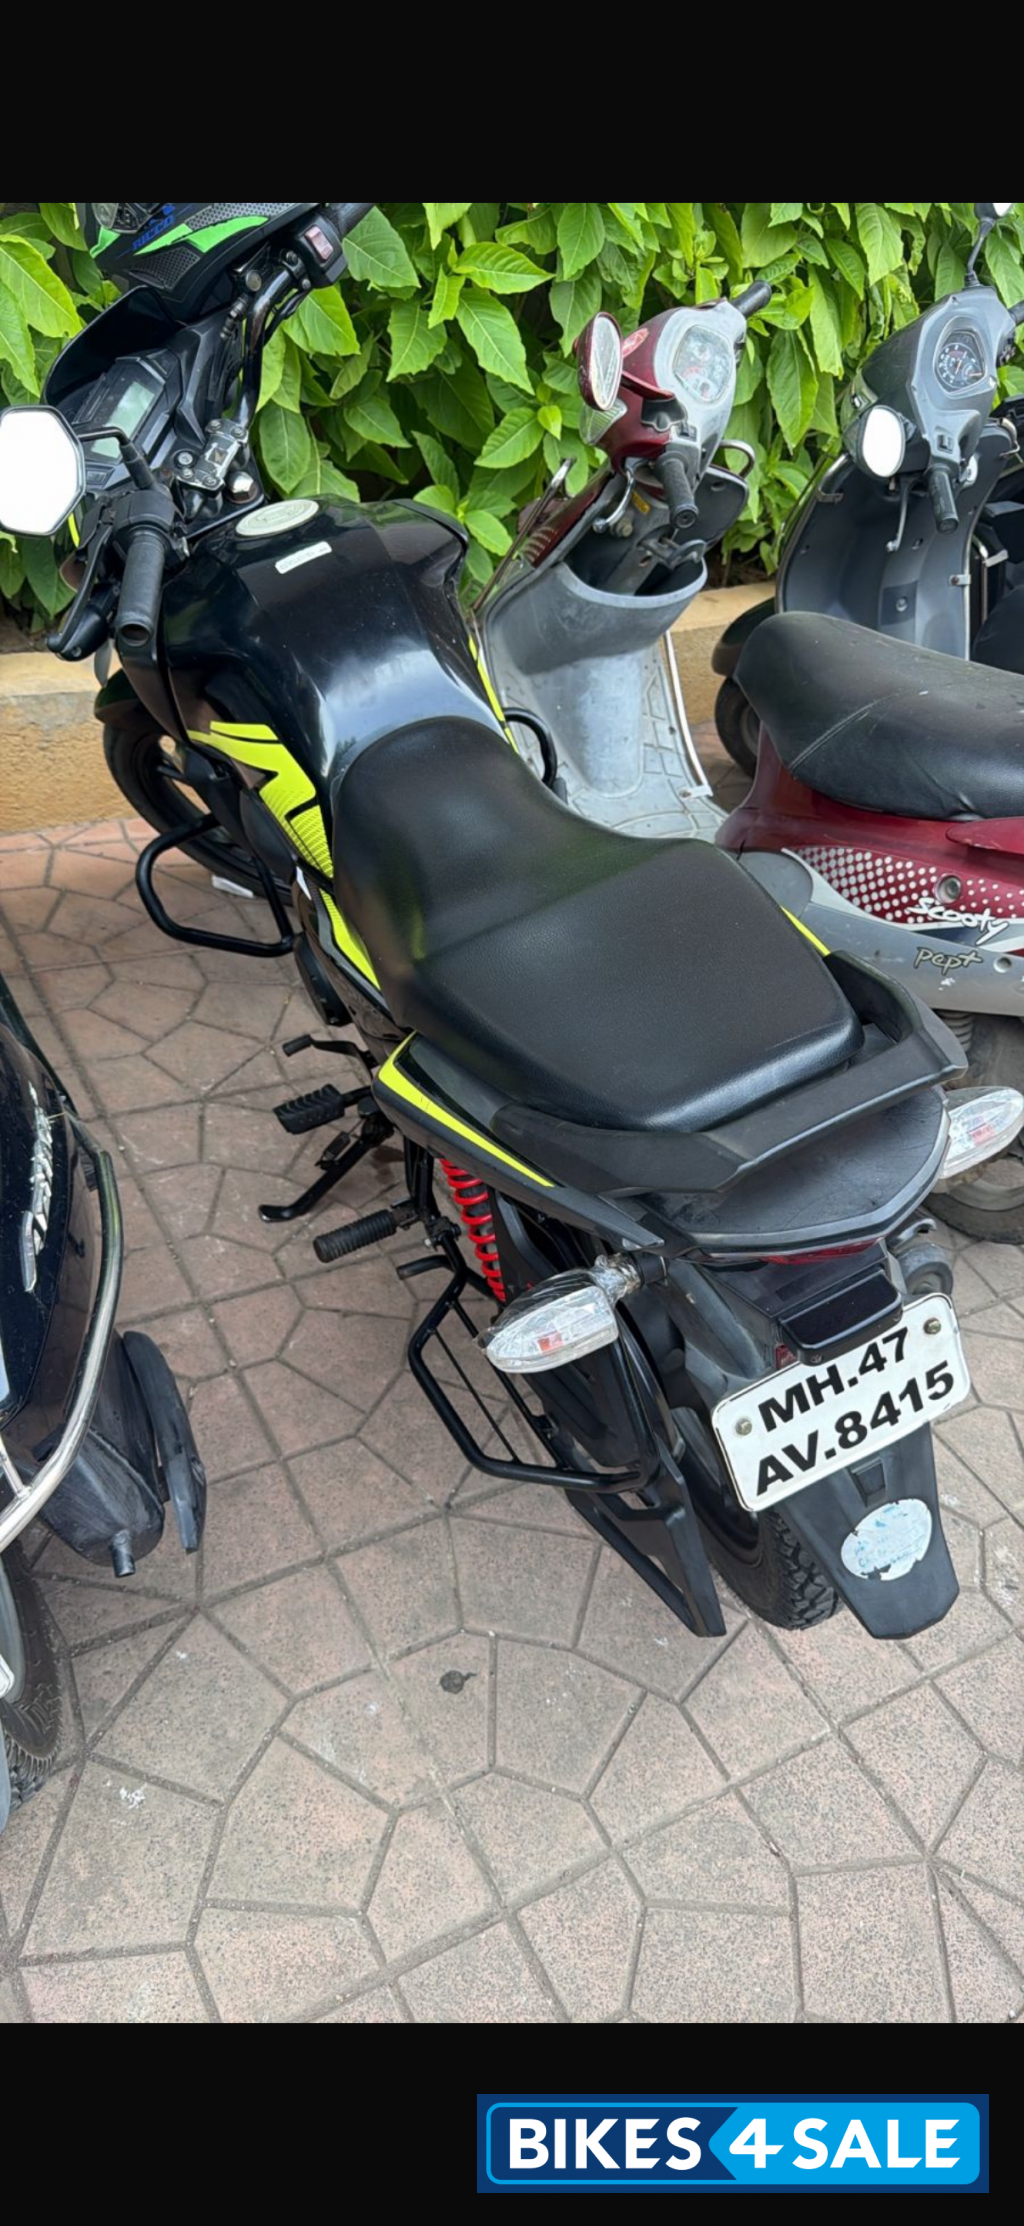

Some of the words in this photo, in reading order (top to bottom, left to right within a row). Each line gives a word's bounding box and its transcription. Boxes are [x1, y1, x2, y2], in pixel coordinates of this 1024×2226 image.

[906, 897, 1009, 946] Scooty
[756, 1359, 955, 1497] AV.8415
[757, 1326, 909, 1433] MH.47
